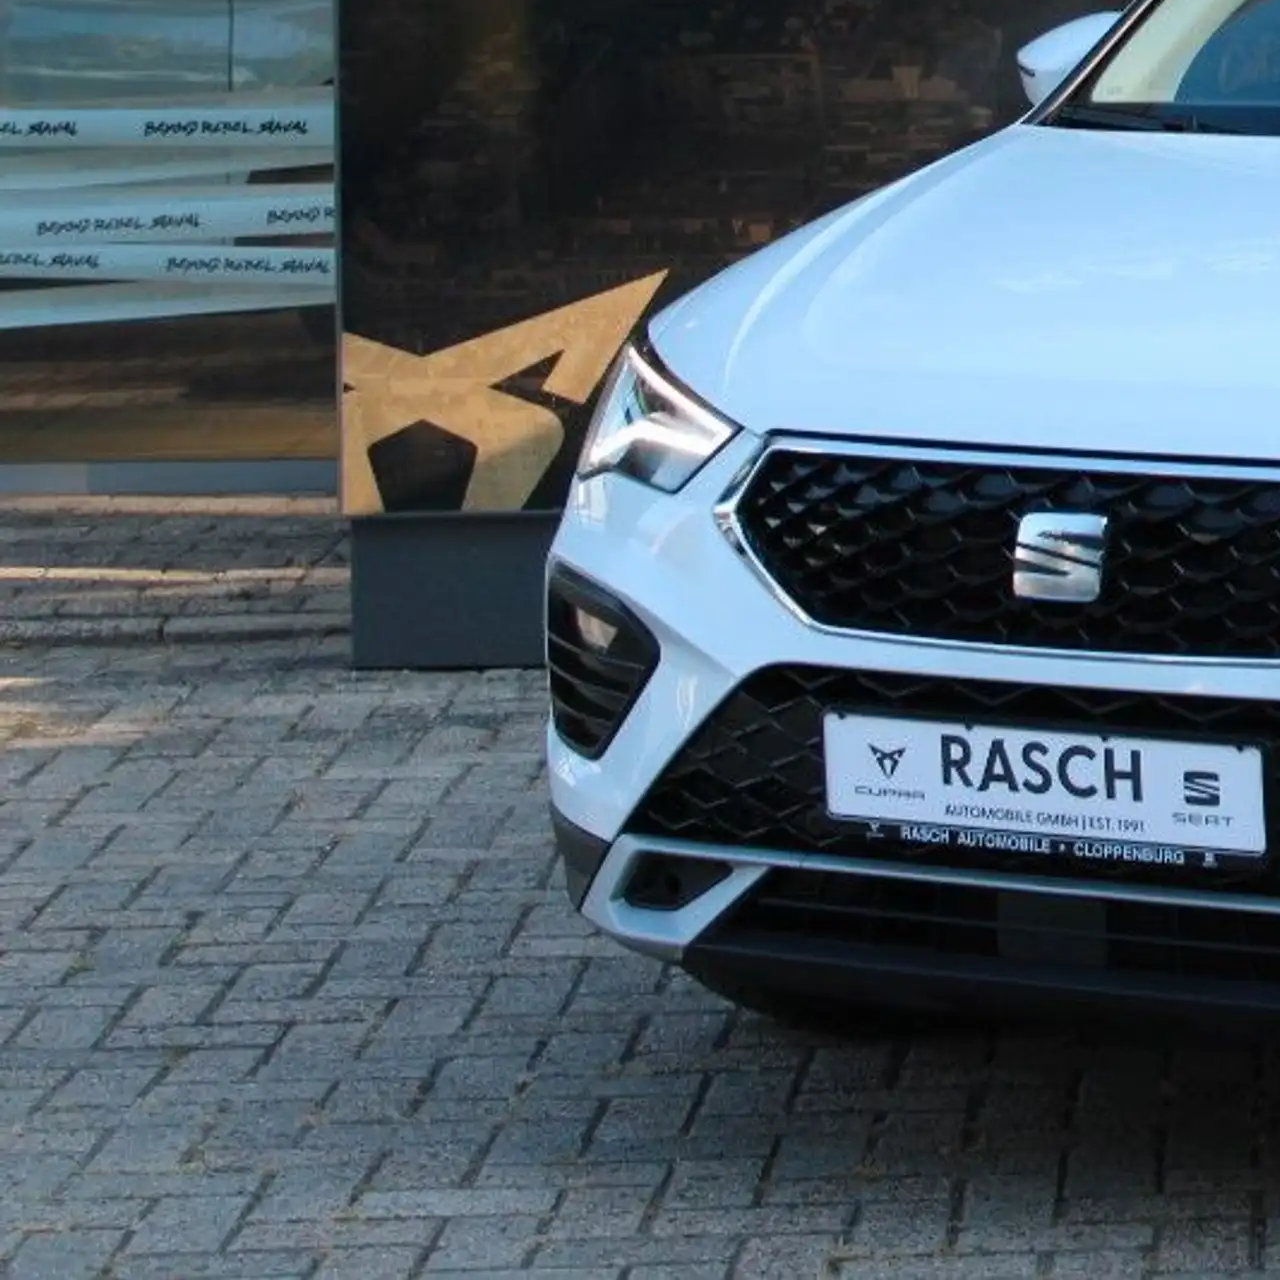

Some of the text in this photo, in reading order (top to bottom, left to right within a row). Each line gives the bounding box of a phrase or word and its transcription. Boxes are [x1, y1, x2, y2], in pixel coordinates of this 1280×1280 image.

[940, 733, 1145, 803] RASCH
[944, 804, 1033, 826] AUTOMOBILE
[1036, 812, 1079, 829] GMBH
[1118, 818, 1145, 834] 1991
[1171, 811, 1235, 827] SEAT
[902, 825, 1185, 865] RASCH AUTOMOBILE CLOPPENBURG
